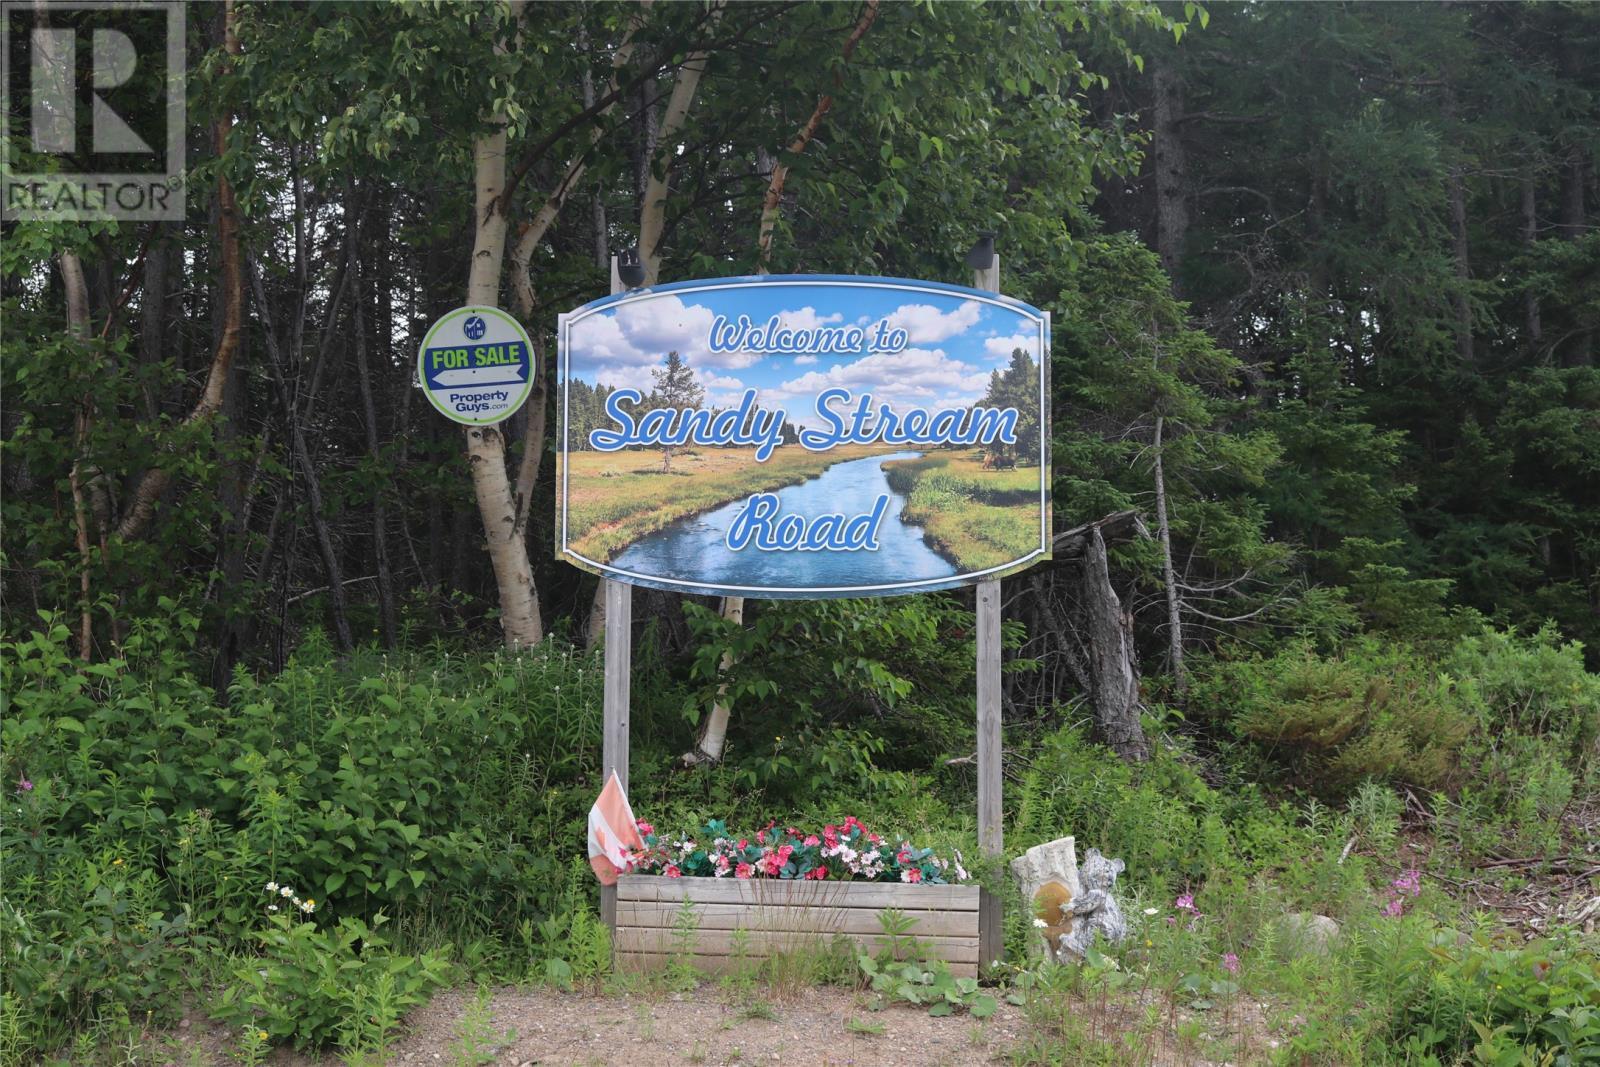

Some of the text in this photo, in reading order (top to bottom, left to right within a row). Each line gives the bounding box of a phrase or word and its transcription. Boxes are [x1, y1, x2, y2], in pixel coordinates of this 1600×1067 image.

[708, 314, 908, 353] Welcome to
[433, 345, 521, 369] FOR SALE
[450, 391, 508, 403] Property
[589, 388, 1020, 462] Sandy Stream
[725, 492, 891, 552] Road
